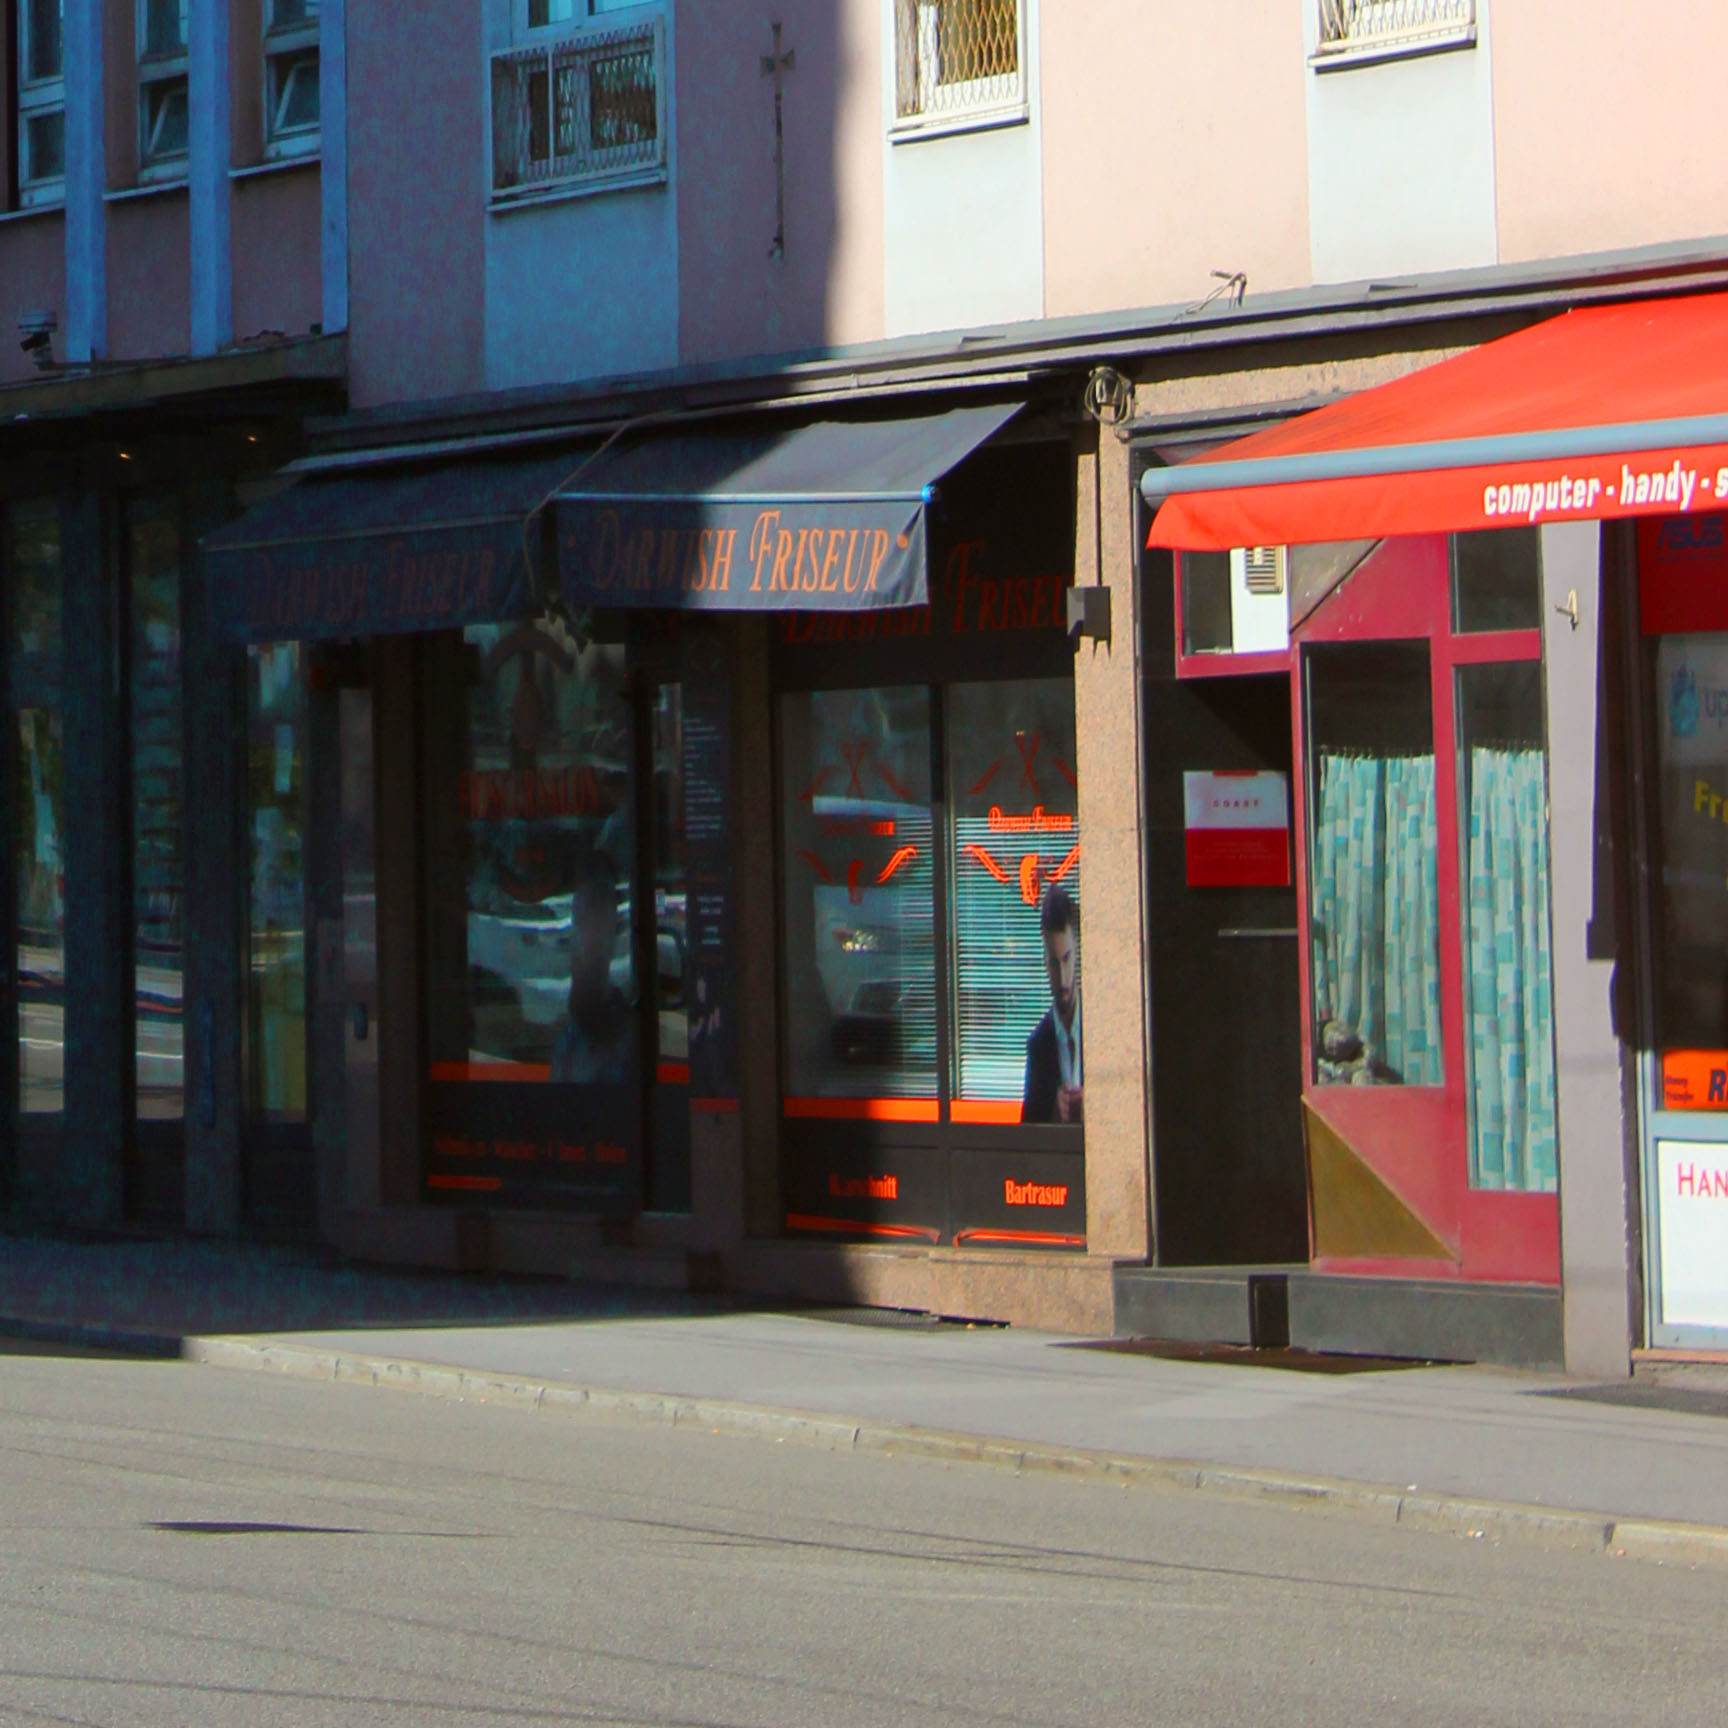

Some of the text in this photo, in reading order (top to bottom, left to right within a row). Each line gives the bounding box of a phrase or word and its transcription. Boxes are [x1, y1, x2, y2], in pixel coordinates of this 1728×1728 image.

[1483, 476, 1600, 521] computer
[1620, 460, 1696, 511] handy
[592, 509, 888, 592] DARWISH FRISEUR
[1658, 516, 1723, 549] ASUS
[1004, 1177, 1068, 1206] Bartrasur
